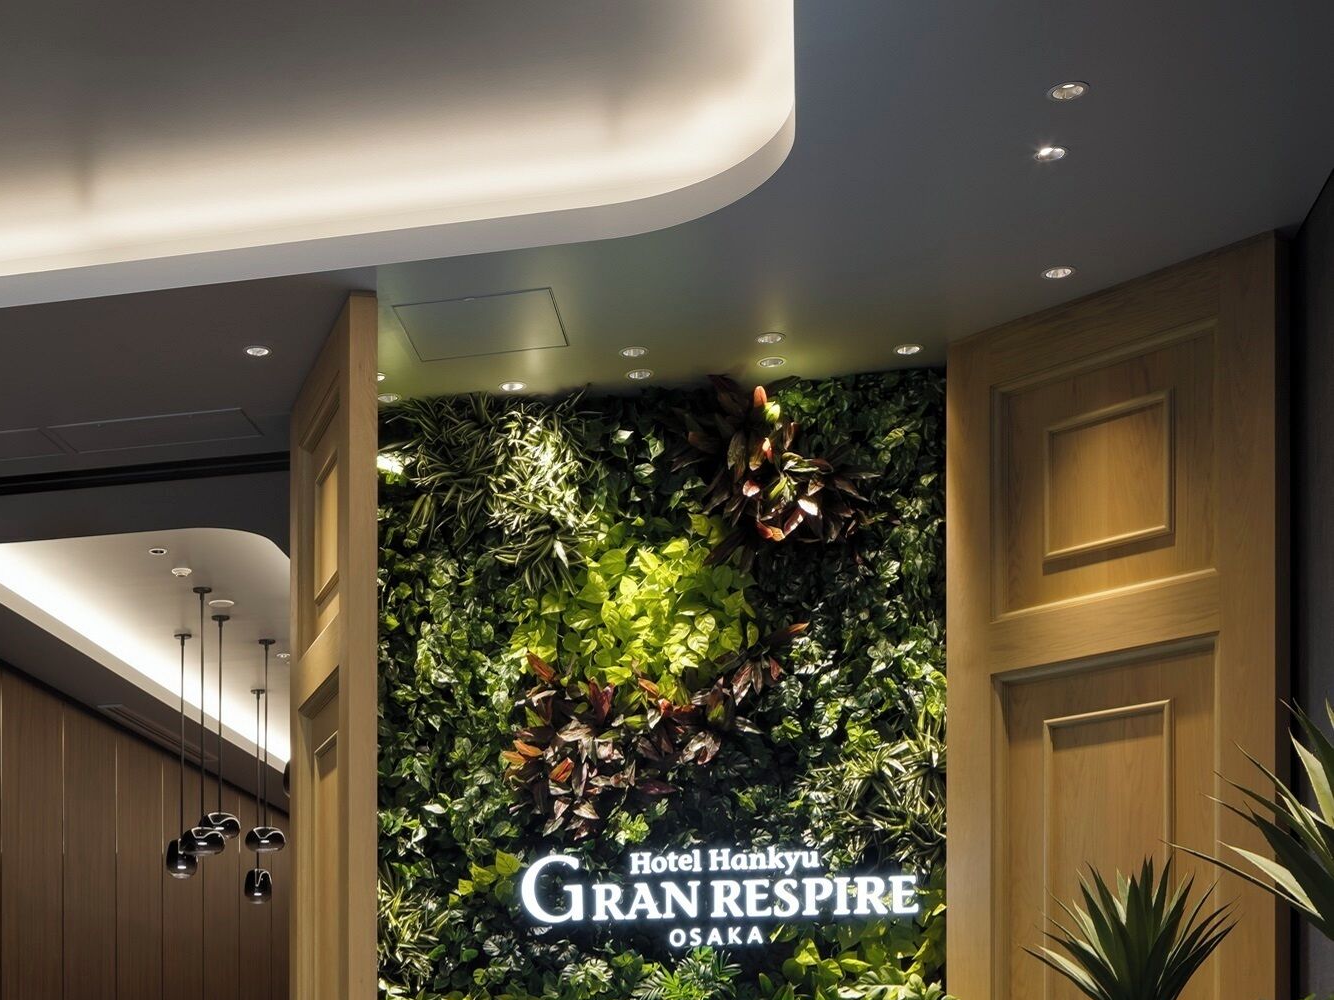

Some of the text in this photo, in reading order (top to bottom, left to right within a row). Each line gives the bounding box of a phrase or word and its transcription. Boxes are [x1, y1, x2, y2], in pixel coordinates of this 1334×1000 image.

[630, 845, 820, 875] Hotel Hankyu
[521, 855, 920, 923] GRAN RESPIRE
[669, 926, 764, 947] OSAKA
